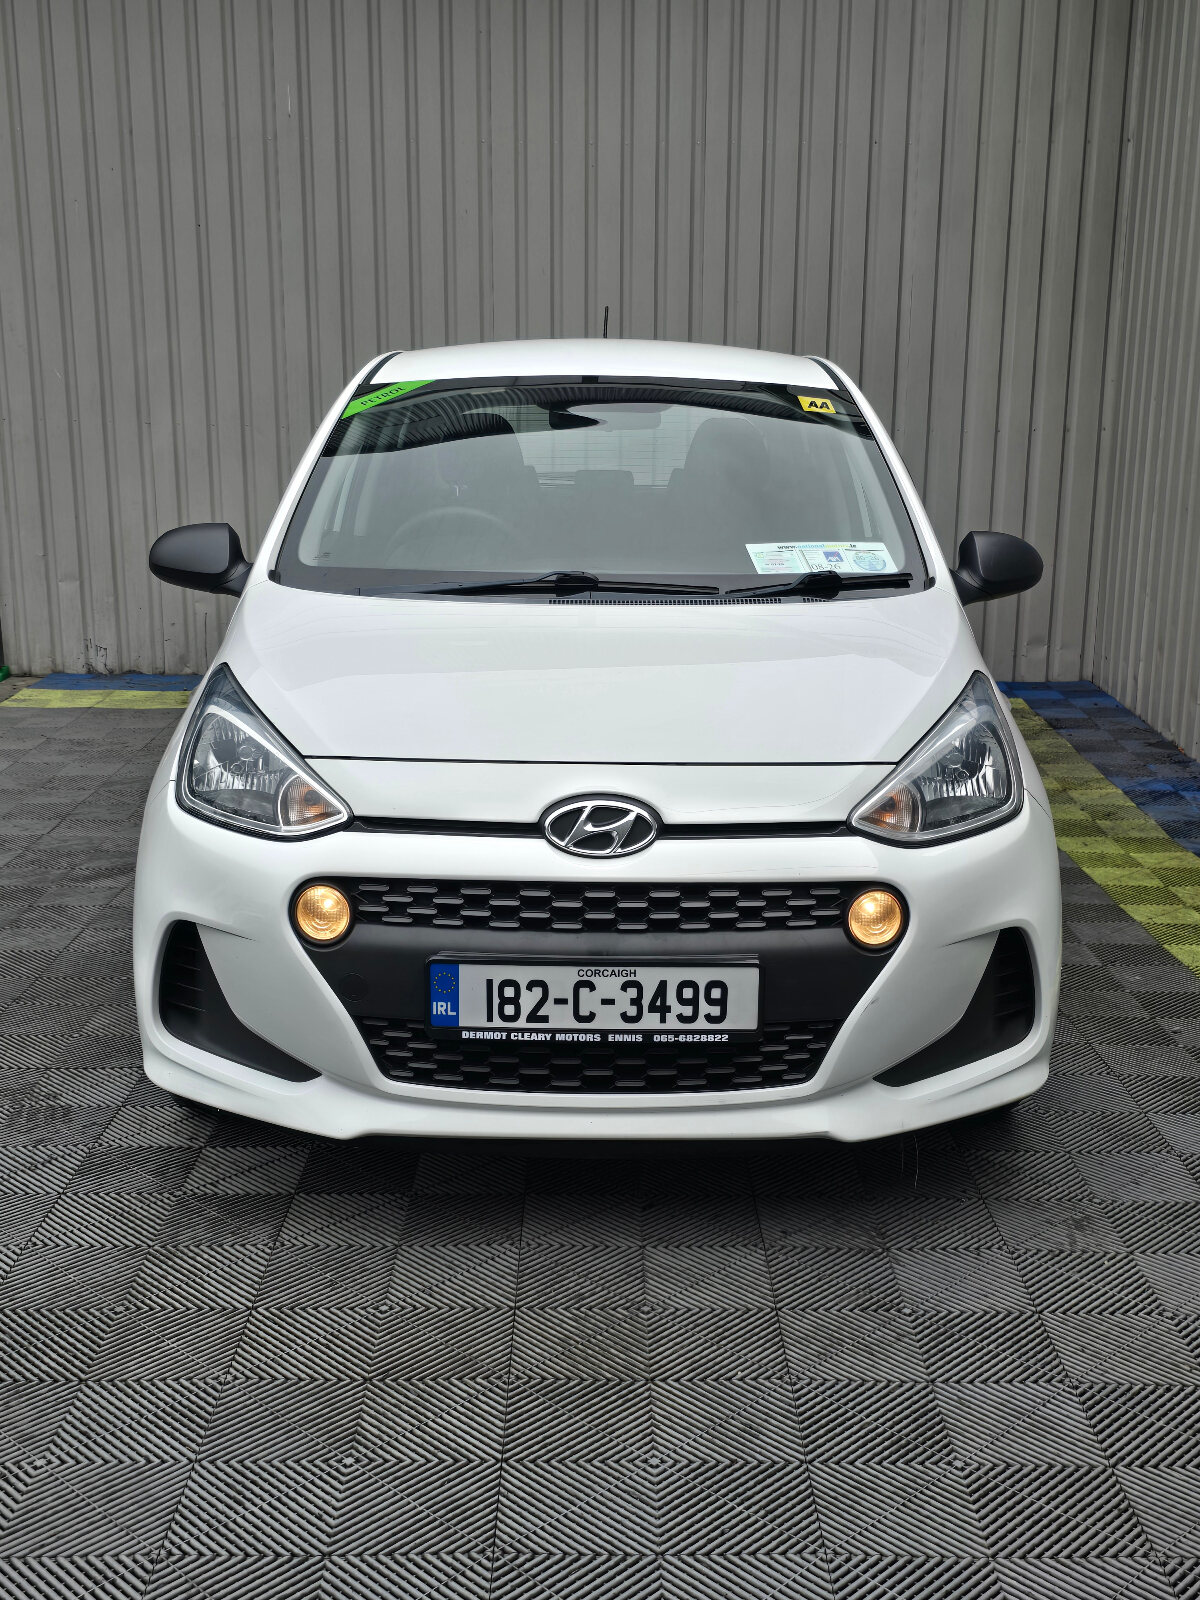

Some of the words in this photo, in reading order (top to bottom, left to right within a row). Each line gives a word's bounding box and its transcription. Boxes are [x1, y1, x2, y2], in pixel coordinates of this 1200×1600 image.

[360, 386, 406, 406] PETROL
[807, 400, 831, 410] AA
[577, 968, 637, 978] CORCAIGH
[432, 1001, 457, 1016] IRL
[485, 978, 729, 1025] 182-C-3499
[461, 1030, 508, 1041] DERMOT
[510, 1031, 553, 1042] CLEARY
[555, 1032, 602, 1042] MOTORS
[607, 1033, 644, 1043] ENNIS
[653, 1033, 730, 1043] 065-6828822
